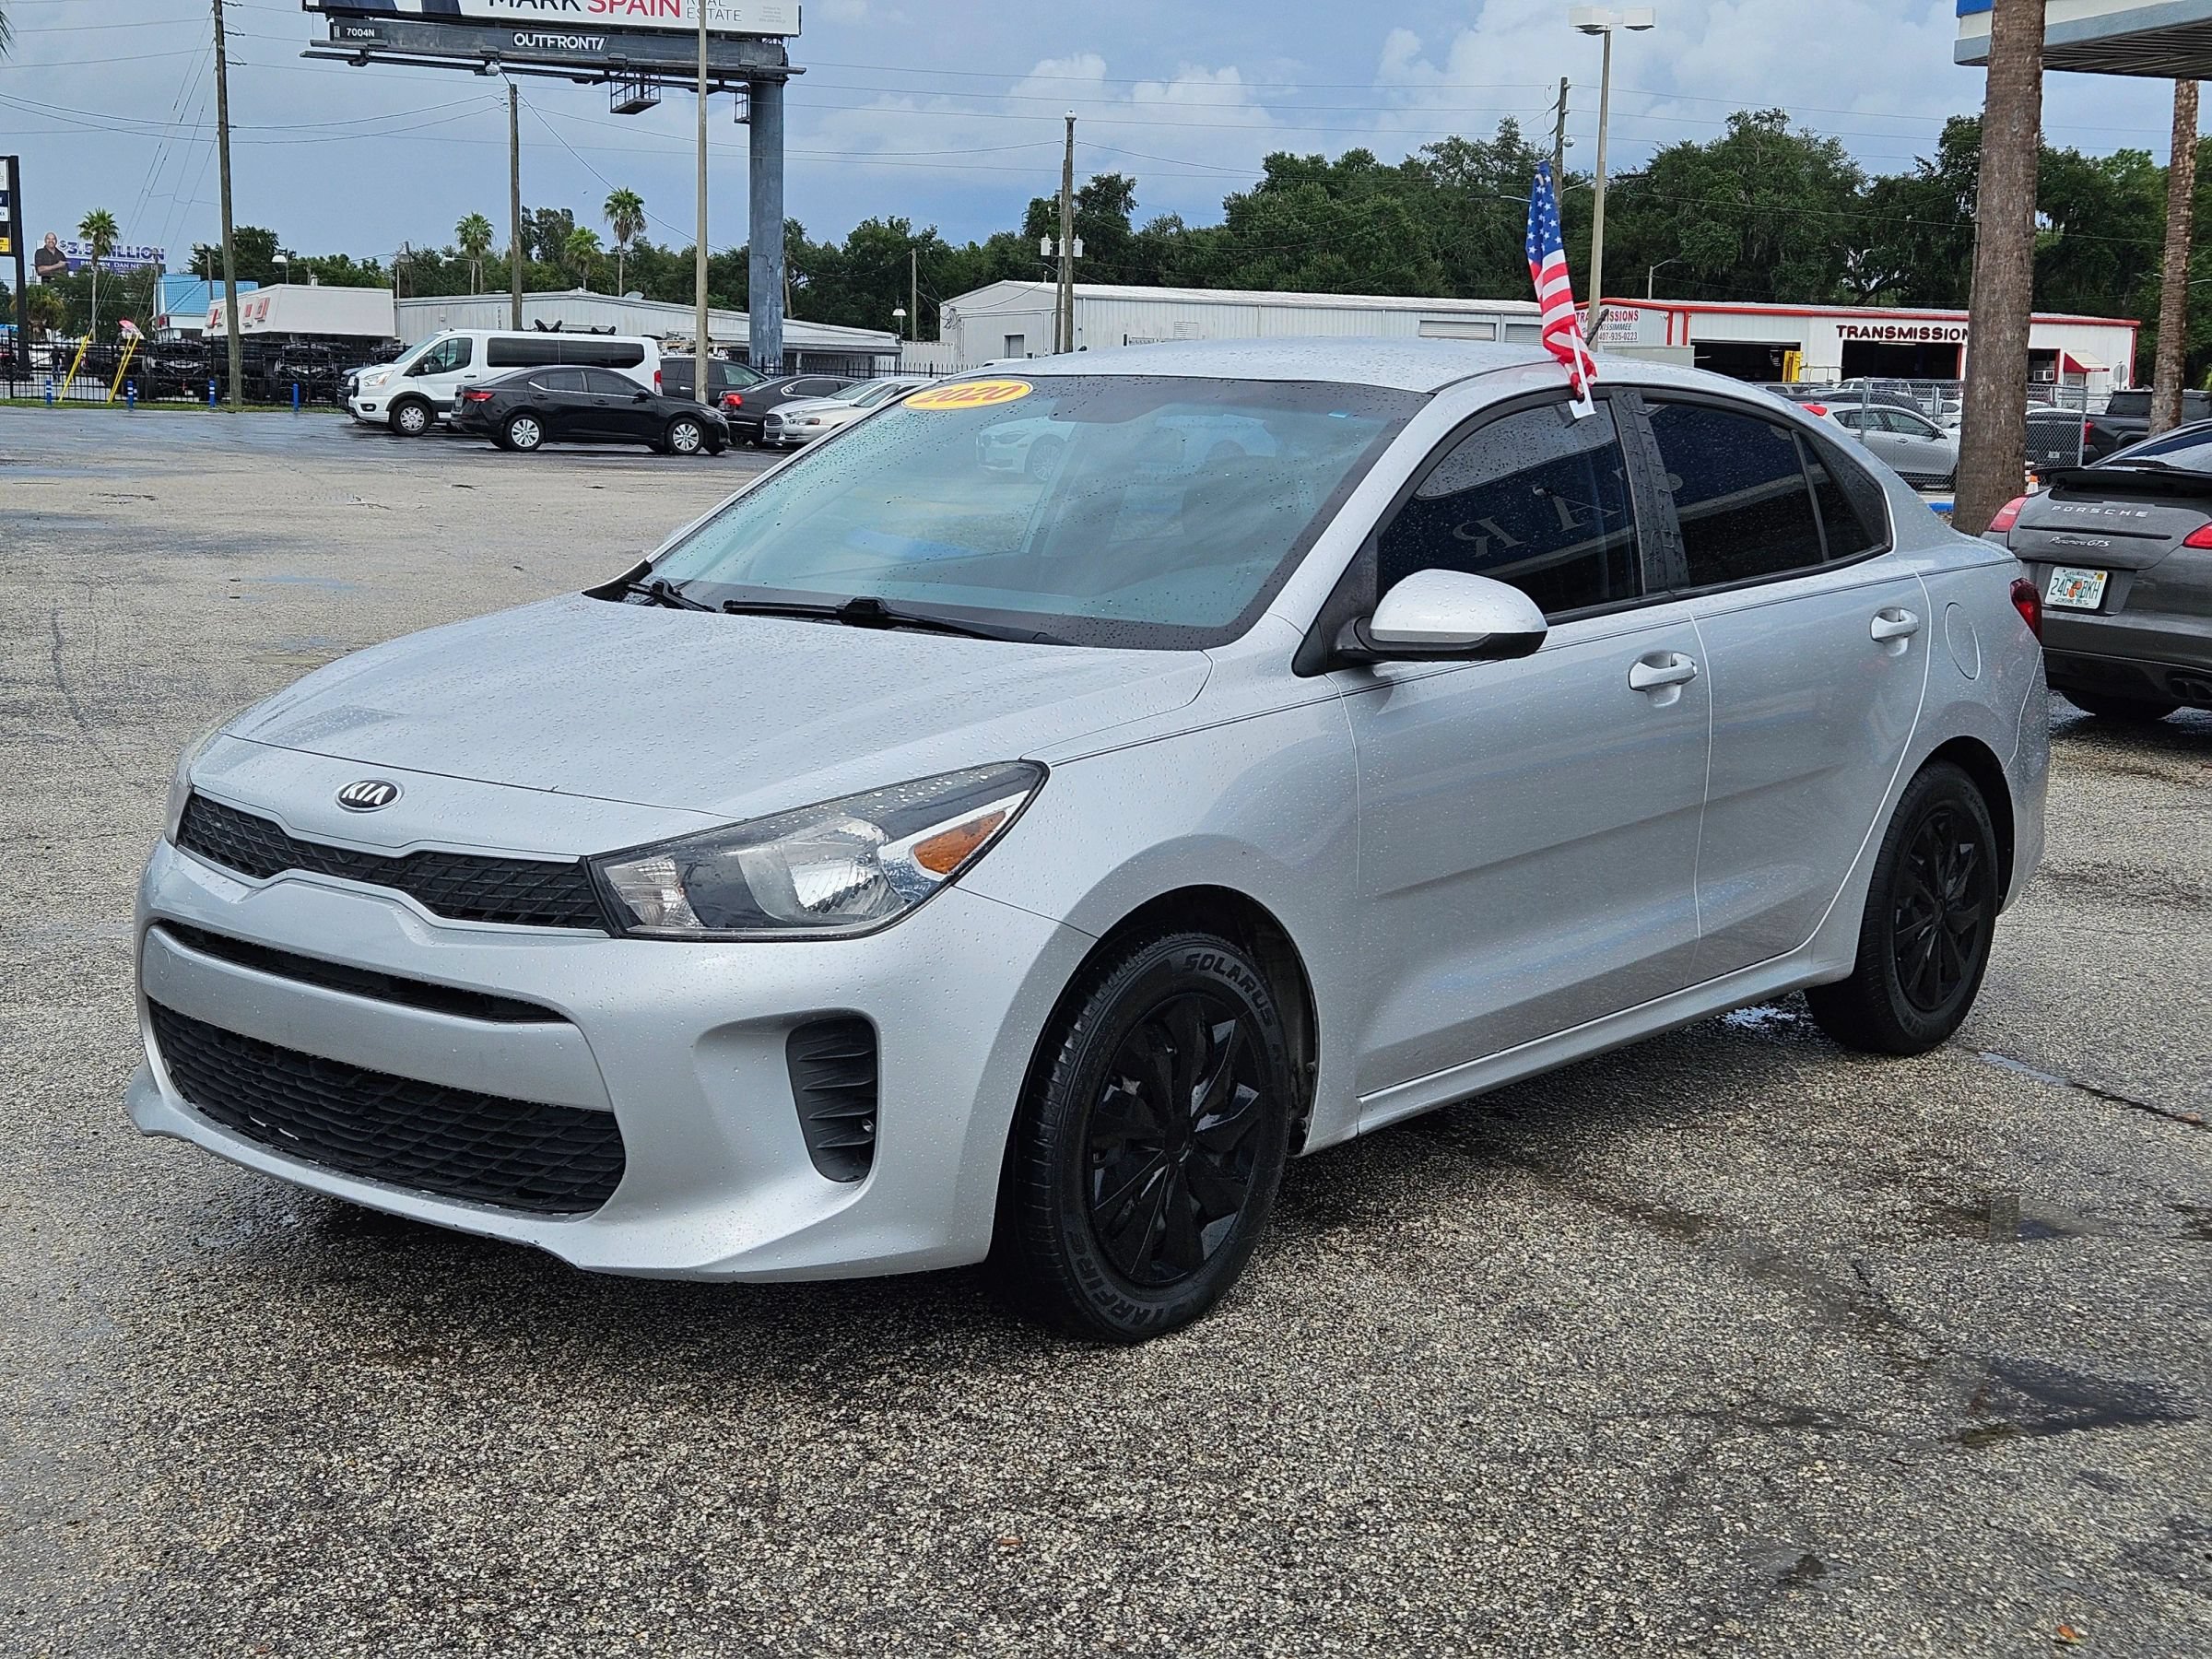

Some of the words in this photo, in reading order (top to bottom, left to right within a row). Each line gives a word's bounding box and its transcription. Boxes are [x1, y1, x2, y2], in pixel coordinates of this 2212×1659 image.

[587, 0, 681, 18] SPAIN
[346, 27, 375, 38] 7004N
[1576, 309, 1639, 323] TRAISSIONS
[909, 384, 1023, 405] 2020
[2051, 505, 2148, 518] PORSCHE
[2087, 538, 2112, 547] GTS
[341, 782, 391, 806] KIA
[1184, 952, 1276, 1027] SOLARUS
